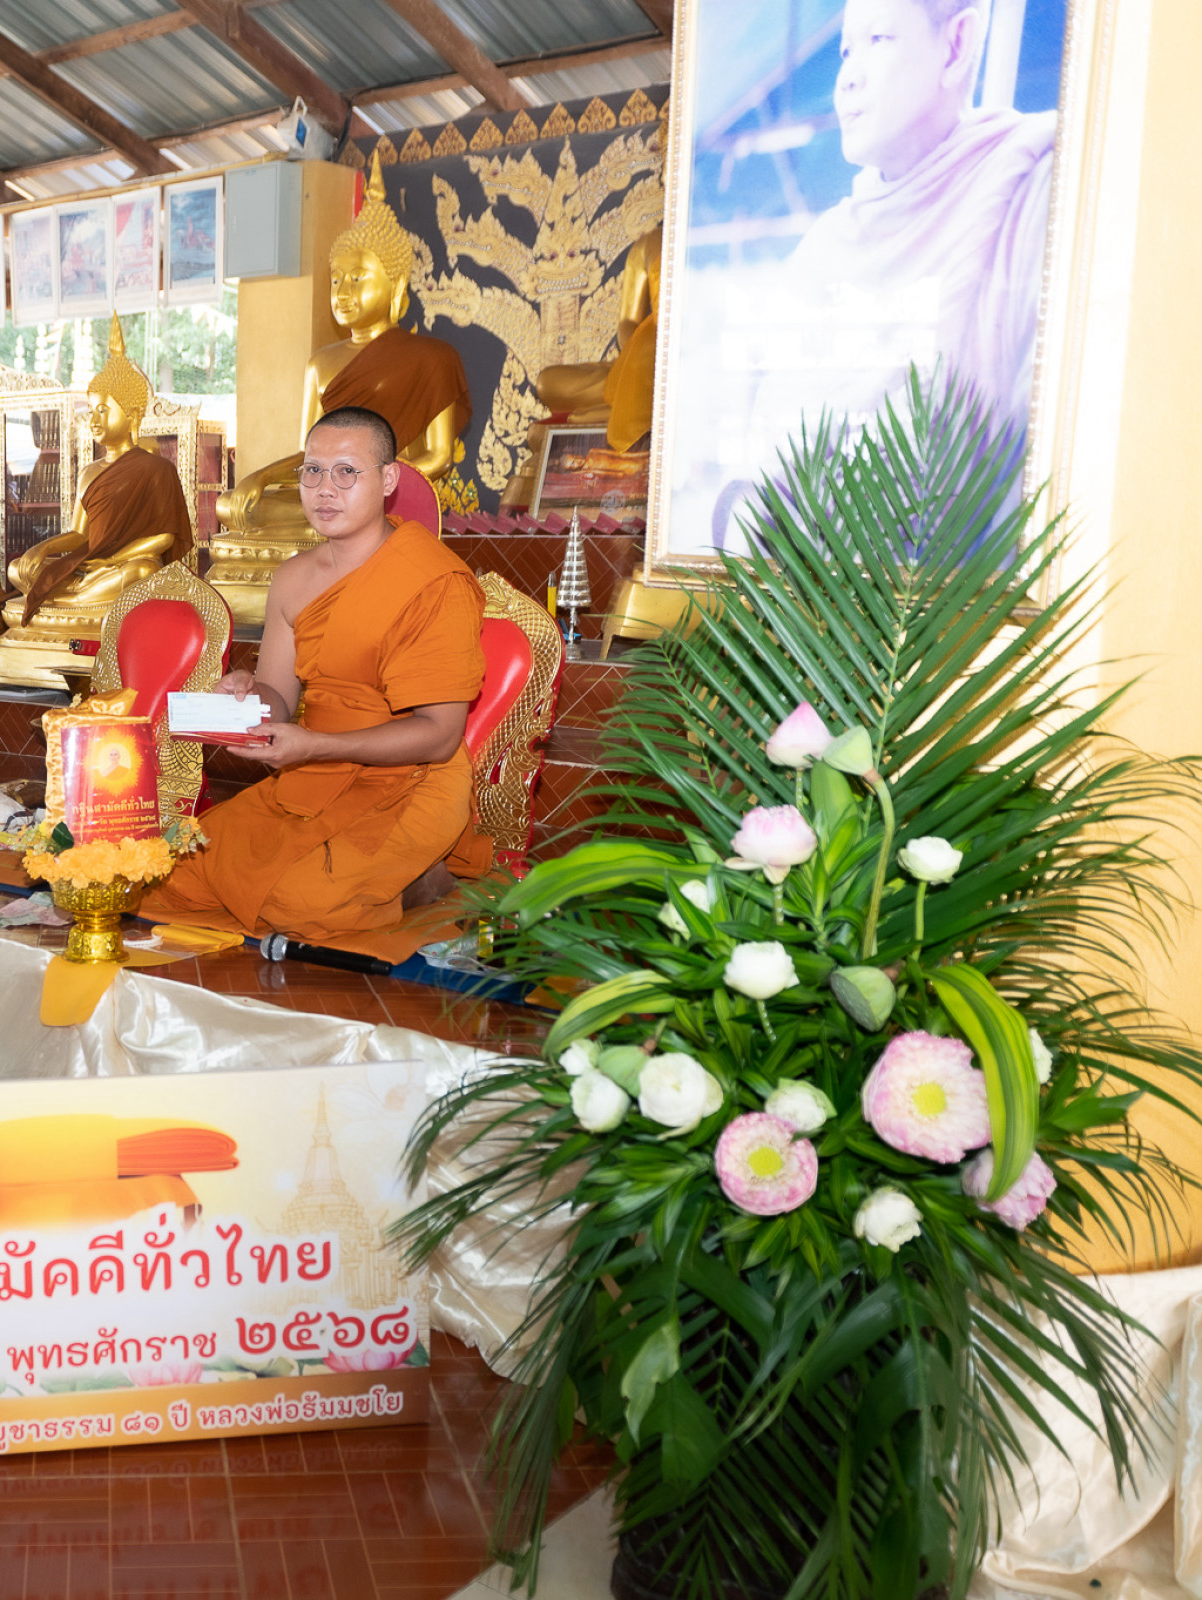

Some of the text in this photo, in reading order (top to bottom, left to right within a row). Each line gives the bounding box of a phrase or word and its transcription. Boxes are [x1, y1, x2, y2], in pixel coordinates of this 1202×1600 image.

[6, 1327, 217, 1385] พุทธศักราช
[235, 1305, 410, 1355] ๒๕๖๘
[124, 1415, 161, 1433] ๘๑
[171, 1403, 189, 1428] ปี
[200, 1387, 402, 1427] หลวงพ่อธัมมชโย
